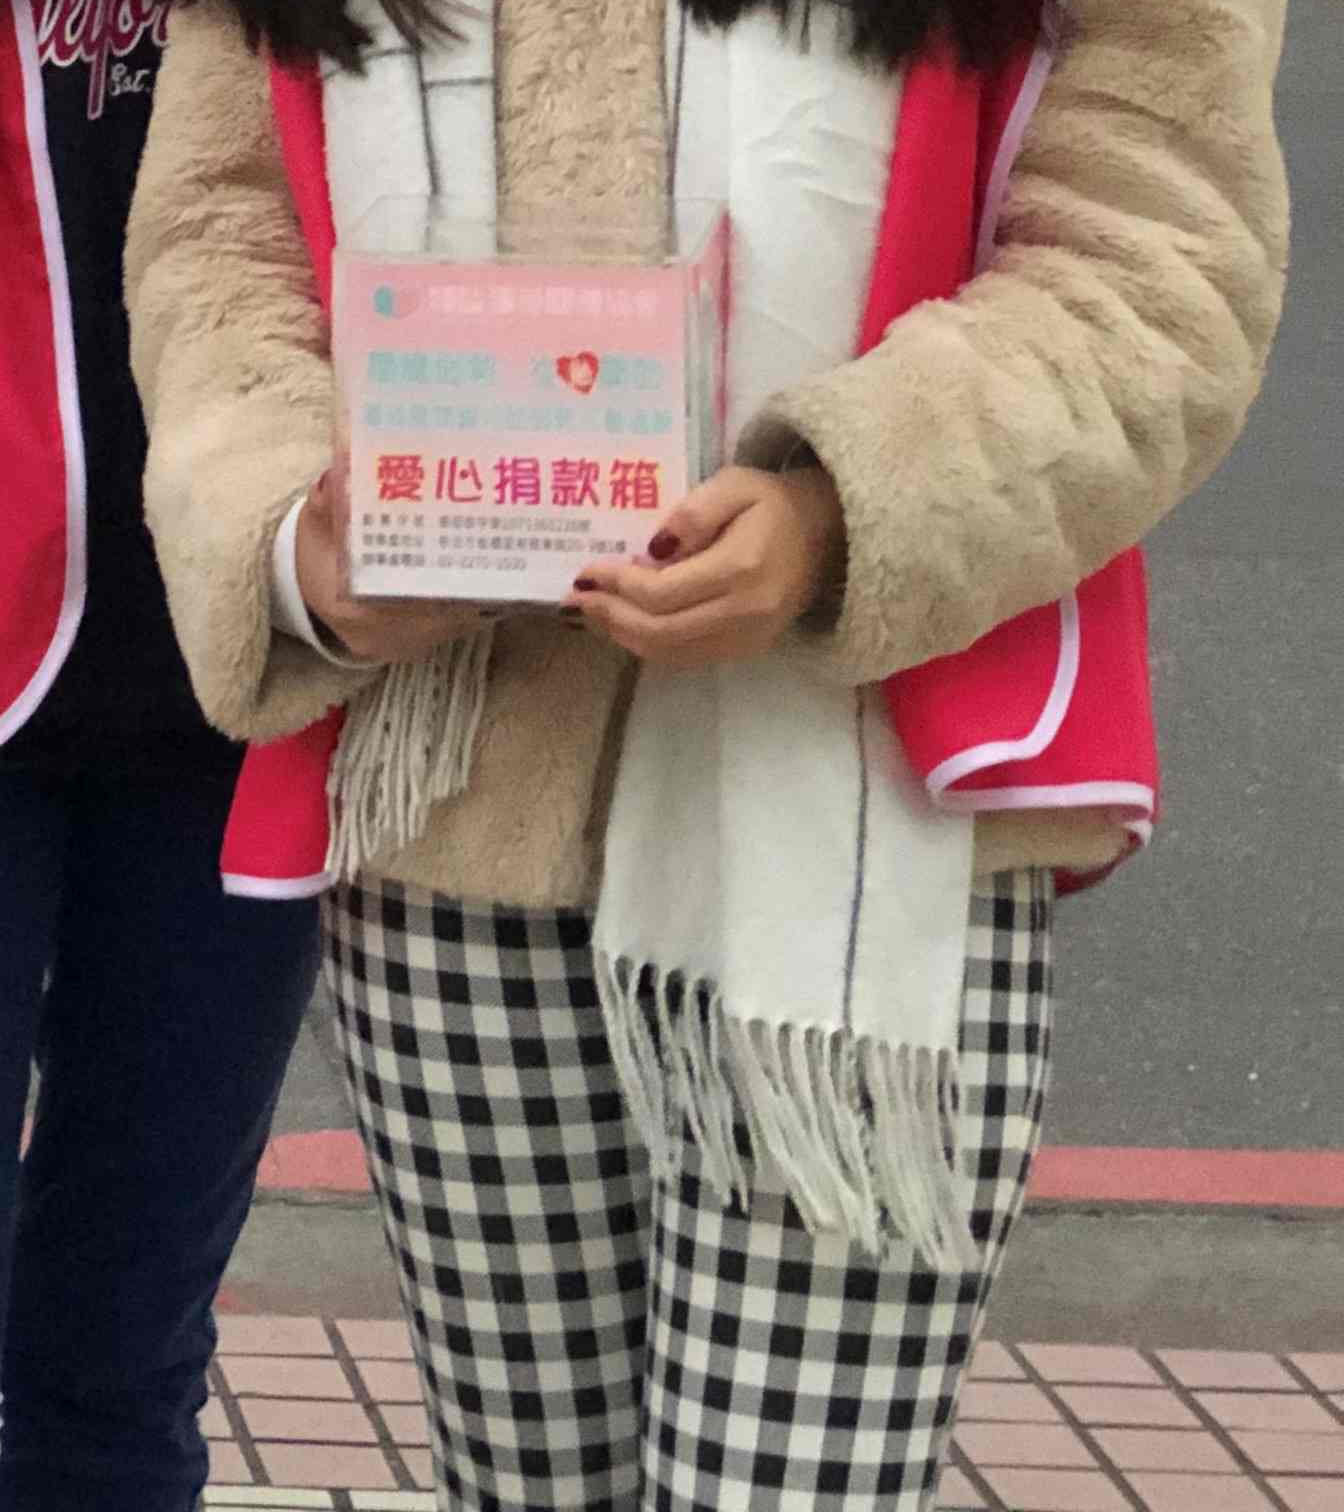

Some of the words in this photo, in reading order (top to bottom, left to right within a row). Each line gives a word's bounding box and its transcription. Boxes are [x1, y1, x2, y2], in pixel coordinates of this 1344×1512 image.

[376, 453, 660, 510] 愛心捐款箱
